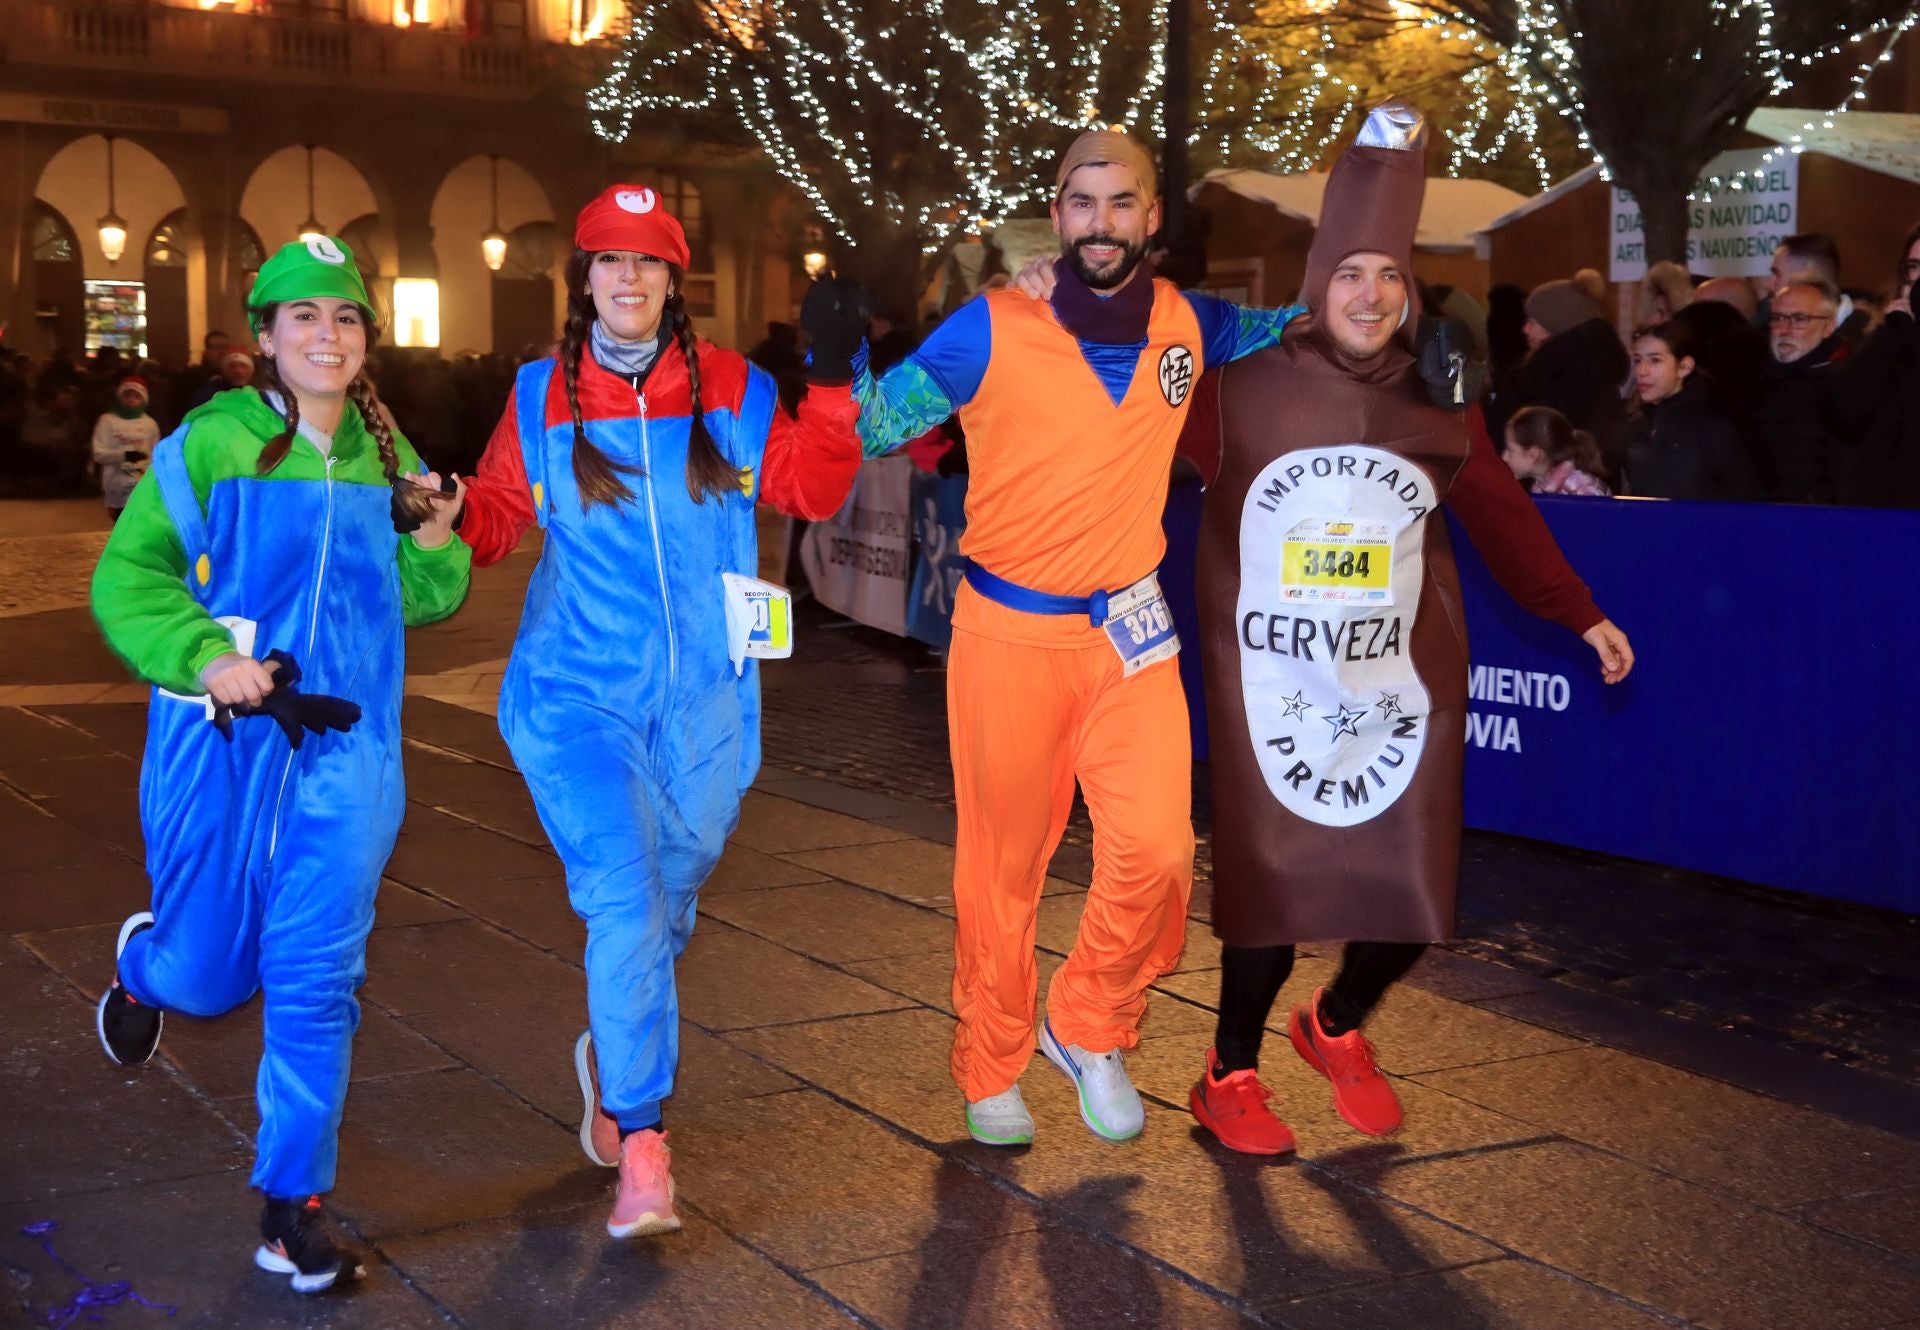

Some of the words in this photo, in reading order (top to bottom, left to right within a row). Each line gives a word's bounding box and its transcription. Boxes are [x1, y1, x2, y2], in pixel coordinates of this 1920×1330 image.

[1742, 170, 1791, 193] NOEL
[1710, 203, 1792, 227] NAVIDAD
[1700, 232, 1784, 260] NAVIDEÑO
[1256, 455, 1427, 523] IMPORTADA
[1304, 549, 1369, 578] 3484
[1241, 611, 1401, 662] CERVEZA
[1467, 663, 1571, 712] MIENTO
[1266, 715, 1419, 809] PREMIUM
